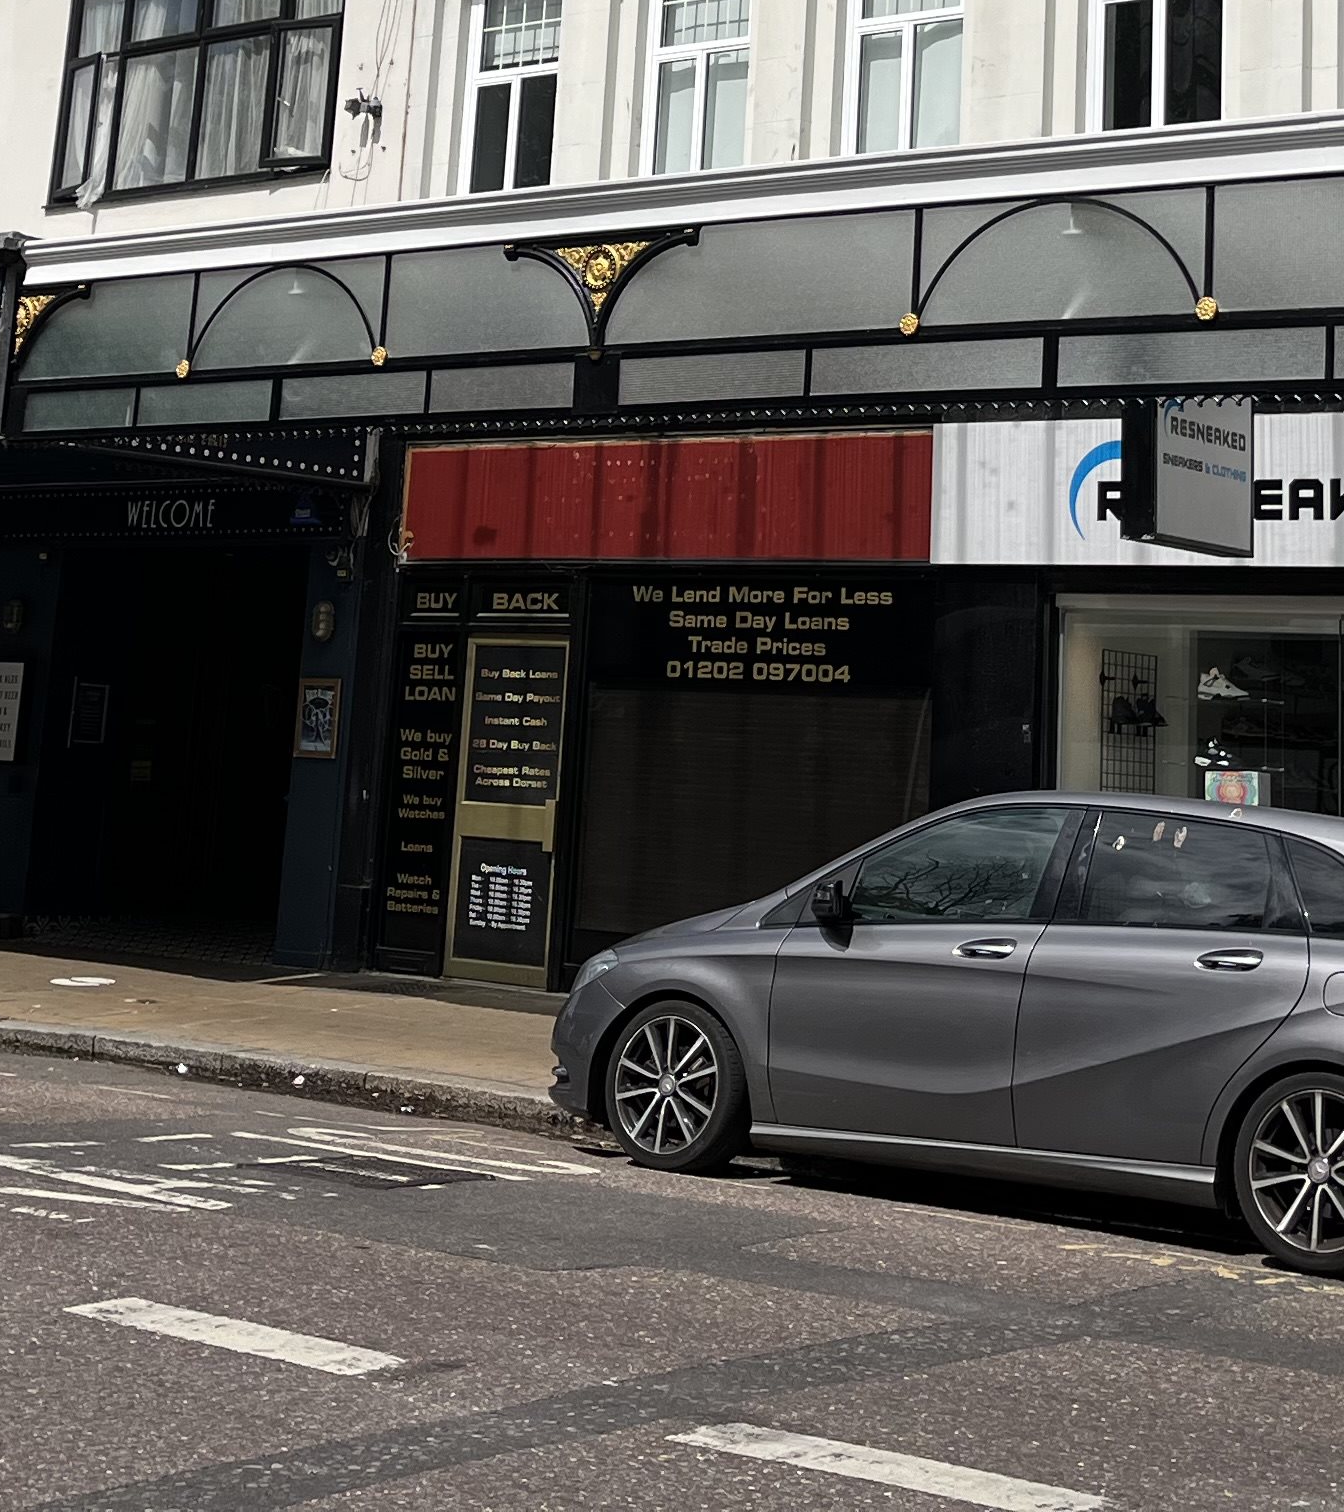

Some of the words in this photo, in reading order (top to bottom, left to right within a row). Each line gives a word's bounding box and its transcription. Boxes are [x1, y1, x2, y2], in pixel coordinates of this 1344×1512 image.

[1170, 415, 1246, 452] RESNEAKED
[1162, 452, 1204, 473] SNEAKERS
[1211, 464, 1247, 483] CLOTHING
[127, 498, 216, 529] WELCOME
[416, 591, 458, 609] BUY
[492, 591, 560, 610] BACK
[632, 585, 664, 604] We
[671, 585, 722, 604] Lend
[728, 586, 786, 605] More
[793, 586, 833, 605] For
[840, 586, 894, 606] Less
[668, 610, 728, 629] Same
[734, 610, 777, 633] Day
[784, 611, 851, 632] Loans
[413, 643, 454, 659] BUY
[687, 636, 749, 655] Trade
[755, 637, 827, 658] Prices
[409, 664, 455, 680] SELL
[480, 668, 500, 680] Buy
[502, 668, 526, 679] Back
[528, 669, 559, 680] Loans
[666, 660, 745, 681] 01202
[751, 662, 852, 685] 097004
[404, 685, 457, 702] LOAN
[475, 691, 503, 702] Same
[504, 692, 525, 704] Day
[526, 692, 561, 705] Payout
[484, 715, 520, 727] Instant
[522, 716, 549, 728] Cash
[399, 728, 422, 743] We
[426, 729, 453, 746] buy
[472, 739, 487, 748] 28
[489, 739, 509, 751] Day
[510, 740, 530, 752] Buy
[532, 740, 558, 751] Back
[400, 747, 433, 761] Gold
[437, 748, 450, 762] &
[401, 765, 446, 782] Silver
[473, 764, 519, 776] Cheapest
[521, 766, 552, 777] Rates
[475, 777, 511, 788] Across
[512, 777, 549, 790] Dorset
[402, 793, 420, 805] We
[422, 794, 443, 807] buy
[398, 807, 446, 820] Watches
[400, 840, 434, 853] Loans
[396, 872, 433, 886] Watch
[386, 886, 429, 900] Repairs
[431, 889, 441, 901] &
[386, 900, 440, 915] Batteries
